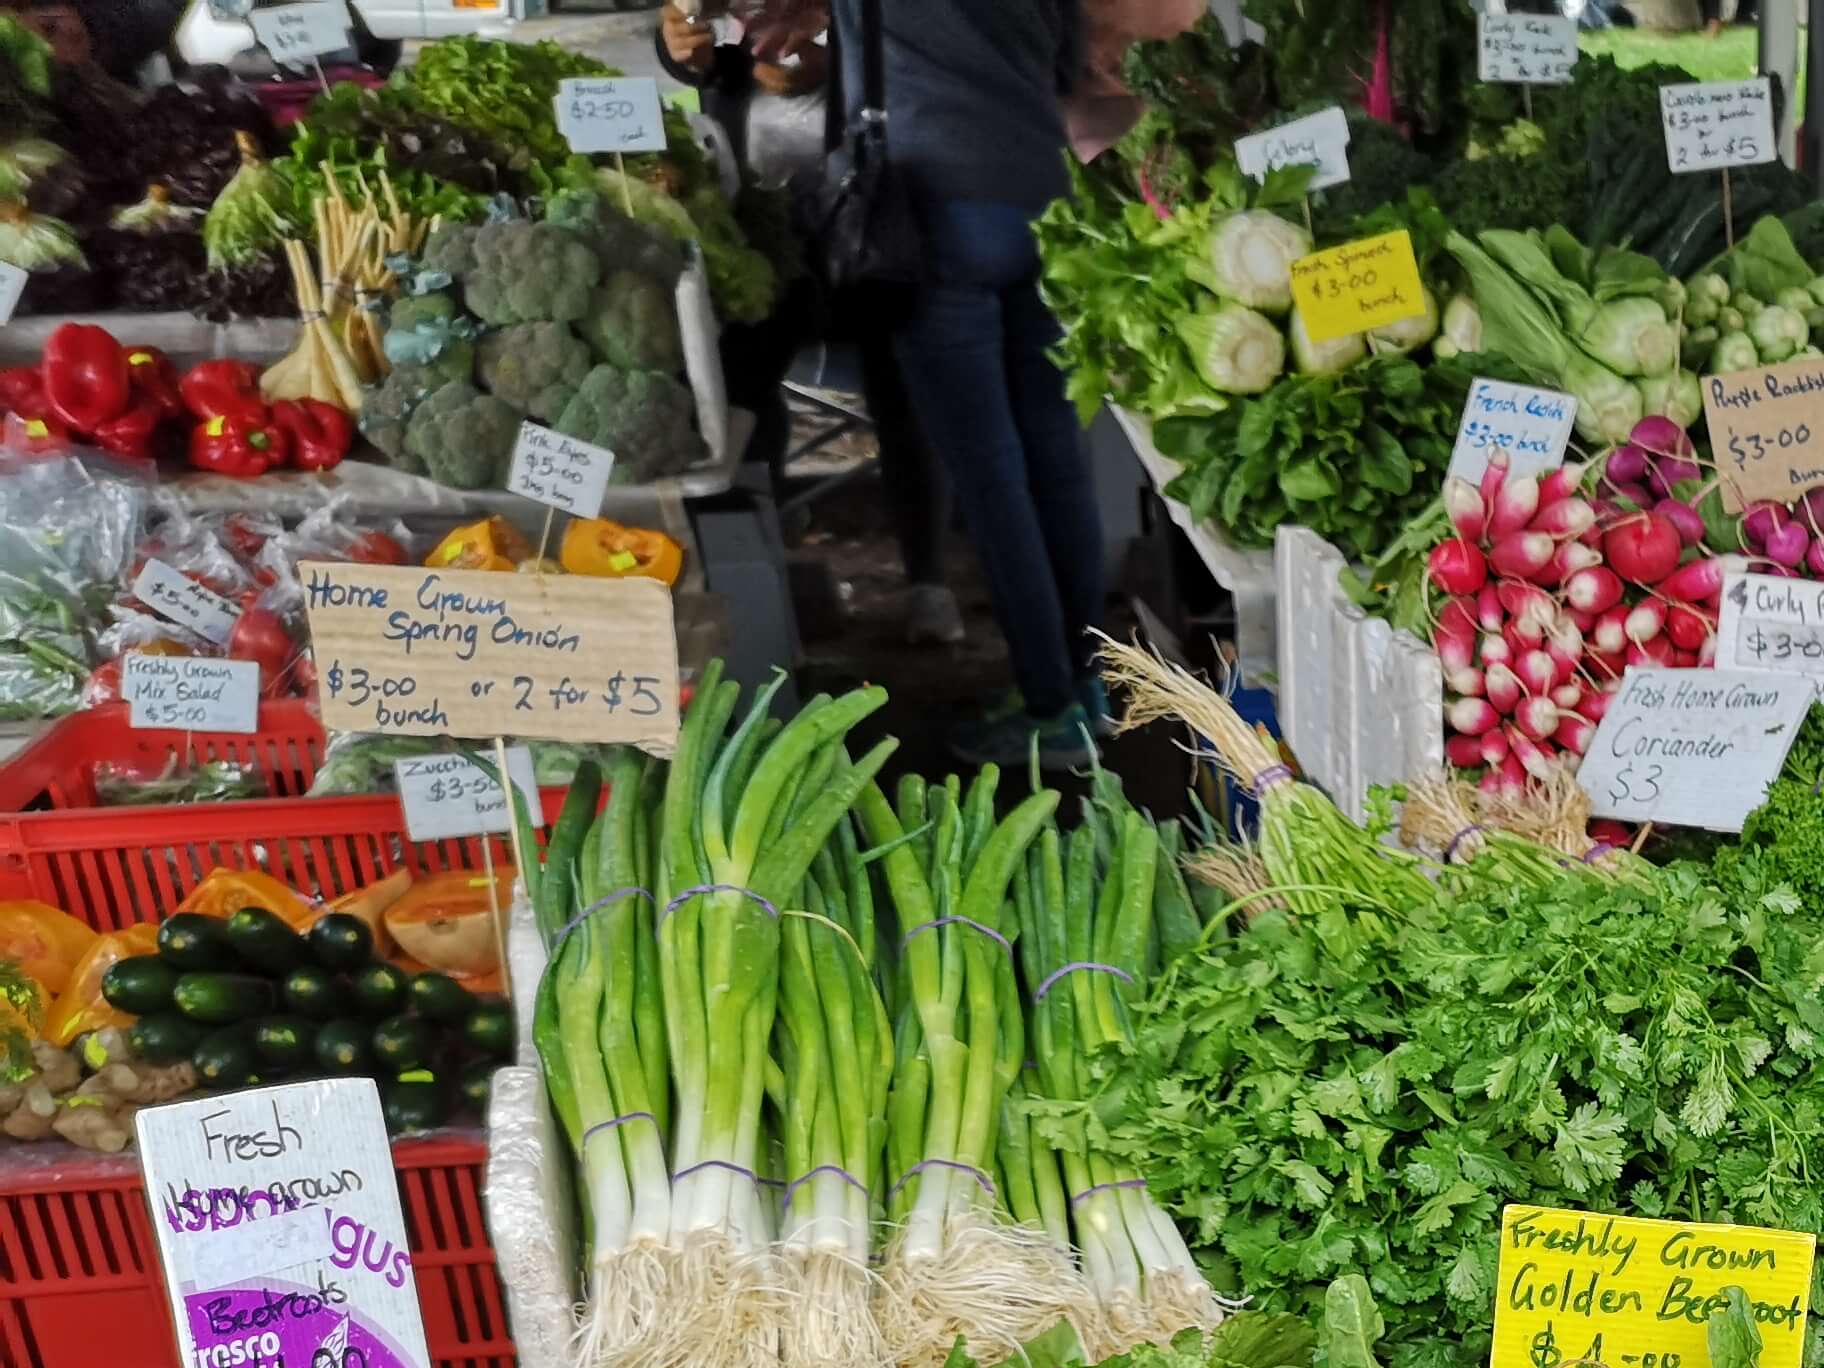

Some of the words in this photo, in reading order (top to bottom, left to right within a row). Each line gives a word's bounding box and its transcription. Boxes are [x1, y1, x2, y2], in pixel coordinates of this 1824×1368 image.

[1711, 378, 1762, 409] Purple
[307, 569, 390, 610] Home
[416, 574, 507, 621] Grown
[1755, 584, 1805, 625] Curly
[383, 611, 479, 661] Spring
[490, 615, 582, 654] Onion
[127, 656, 180, 685] Freshly
[134, 680, 167, 699] Mix
[176, 680, 226, 703] Salad
[327, 659, 417, 707] $3-00
[471, 680, 495, 698] or
[513, 675, 535, 712] 2
[549, 678, 590, 711] for
[603, 670, 664, 717] $5
[1622, 671, 1673, 709] Fresh
[1671, 678, 1725, 710] Home
[375, 697, 449, 728] bunch
[1611, 715, 1735, 759] Coriander
[1607, 760, 1663, 807] $3
[200, 1099, 302, 1164] Fresh
[1509, 1210, 1638, 1277] Freshly
[1659, 1231, 1776, 1270] Grown
[1510, 1261, 1642, 1317] Golden
